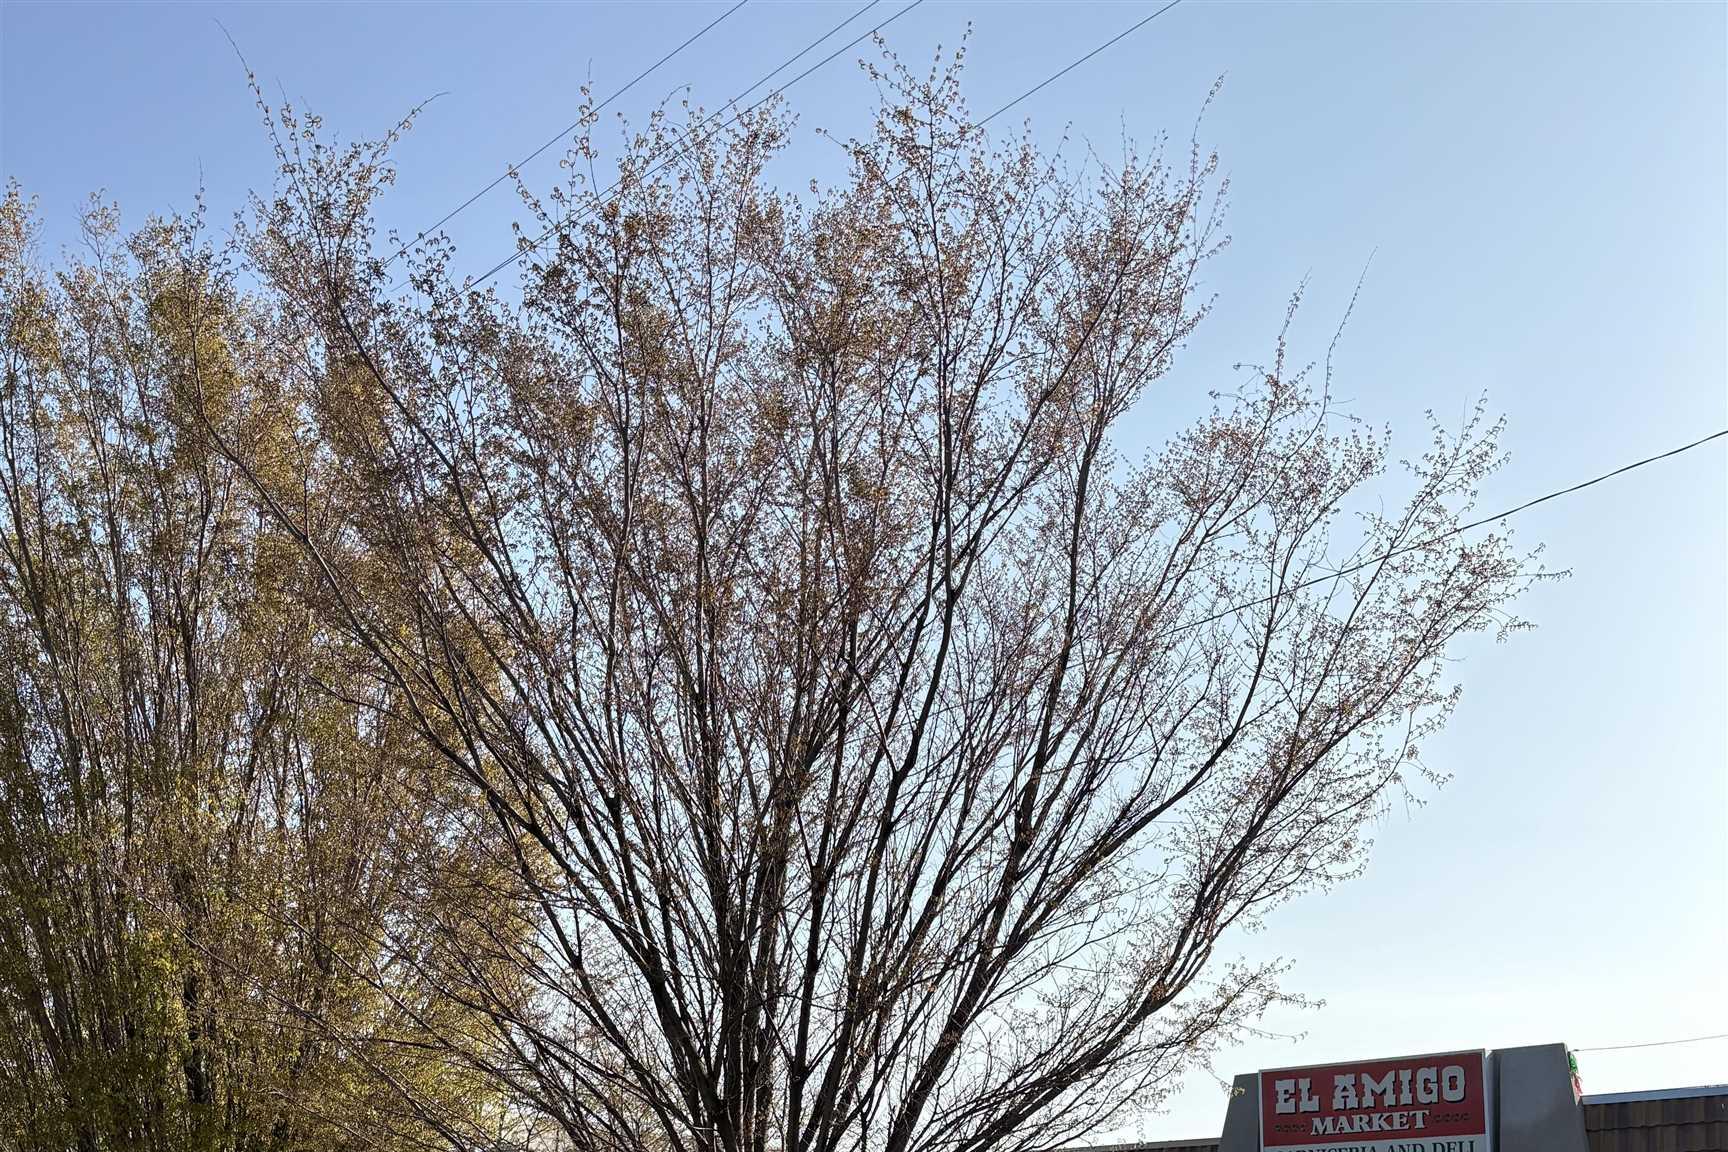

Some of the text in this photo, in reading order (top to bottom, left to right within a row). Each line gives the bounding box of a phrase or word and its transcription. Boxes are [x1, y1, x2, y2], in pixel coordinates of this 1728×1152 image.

[1275, 1065, 1466, 1114] EL AMIGO
[1310, 1109, 1431, 1136] MARKET
